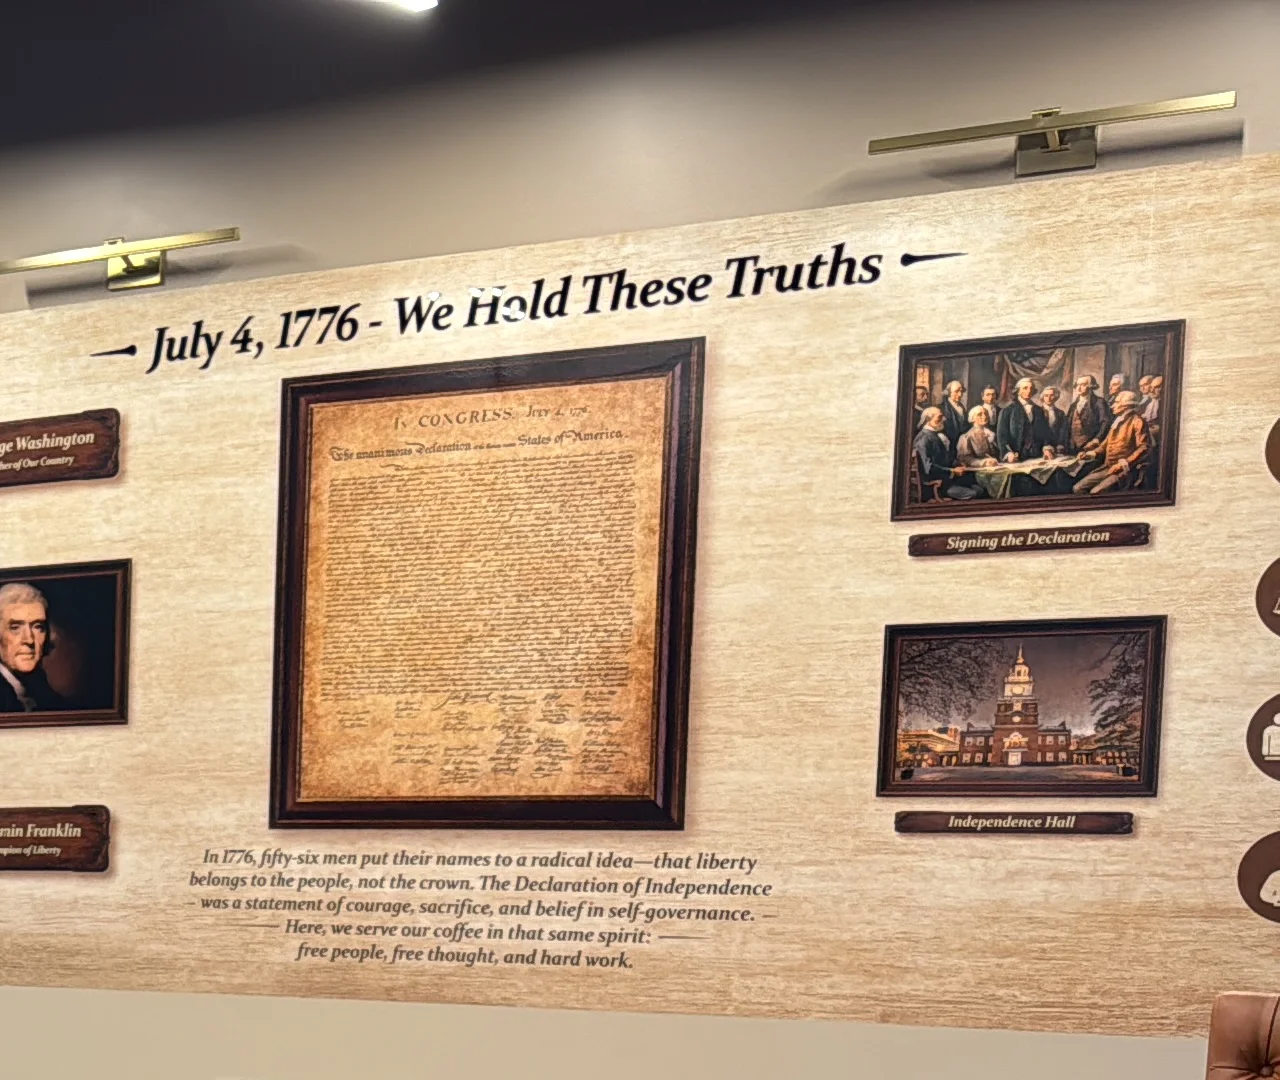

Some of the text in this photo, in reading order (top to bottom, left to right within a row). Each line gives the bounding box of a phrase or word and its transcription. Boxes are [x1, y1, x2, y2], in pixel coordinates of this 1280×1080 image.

[146, 319, 225, 375] July
[230, 315, 264, 359] 4,
[274, 302, 362, 350] 1776
[393, 292, 454, 335] We
[463, 274, 573, 329] Hold
[582, 267, 713, 315] These
[725, 242, 884, 299] Truths
[16, 433, 95, 450] Washington
[518, 433, 552, 447] States
[13, 459, 23, 471] of
[23, 458, 39, 468] Our
[41, 456, 75, 467] Country
[947, 530, 1110, 552] Signing the Declaration
[26, 822, 81, 838] Franklin
[948, 815, 1076, 831] Independence Hall
[22, 845, 32, 857] of
[32, 845, 61, 857] Liberty
[203, 848, 758, 876] In 1776, fifty-six men put their names to a radical idea—that liberty
[190, 871, 773, 899] belongs to the people, not the crown. The Declaration of Independence
[200, 896, 756, 924] was a statement of courage, sacrifice, and belief in self-governance.
[285, 919, 652, 948] Here, we serve our coffee in that same spirit:
[294, 942, 634, 969] free people, free thought, and hard work.
